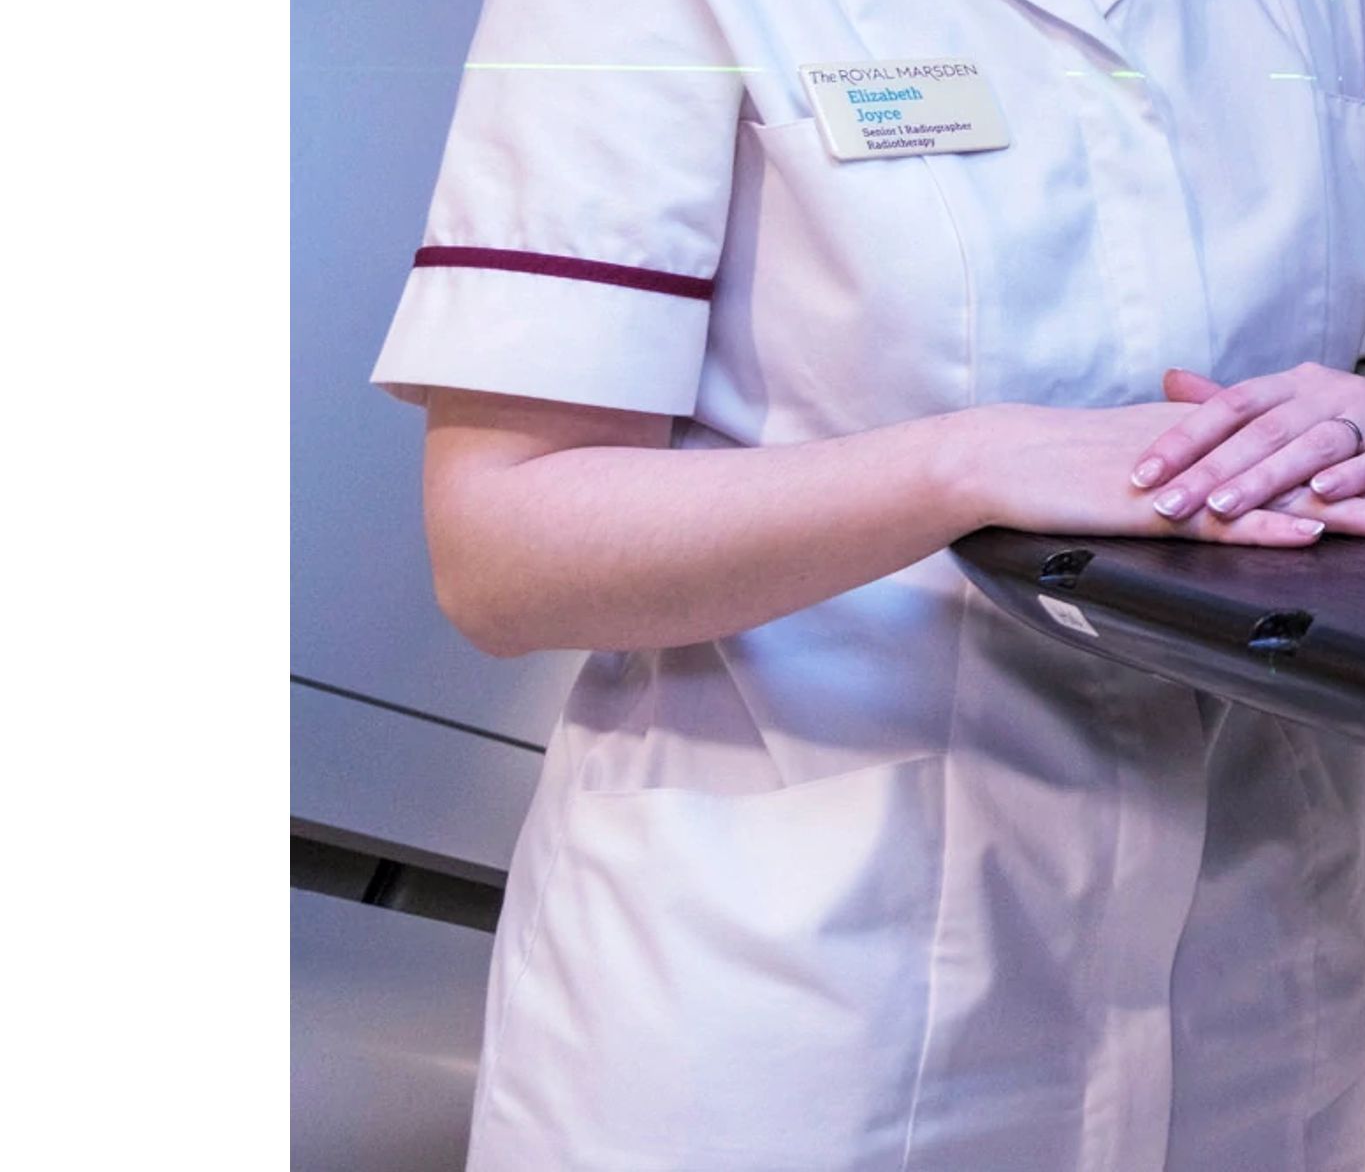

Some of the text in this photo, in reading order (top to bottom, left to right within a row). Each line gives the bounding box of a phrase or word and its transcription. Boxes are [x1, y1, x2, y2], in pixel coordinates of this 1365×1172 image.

[809, 64, 978, 85] The ROYAL MARSDEN
[847, 87, 924, 104] Elizabeth
[857, 108, 902, 123] Joyce
[862, 127, 897, 138] Senior
[904, 122, 972, 135] Radiographer
[867, 137, 936, 150] Radiotherapy
